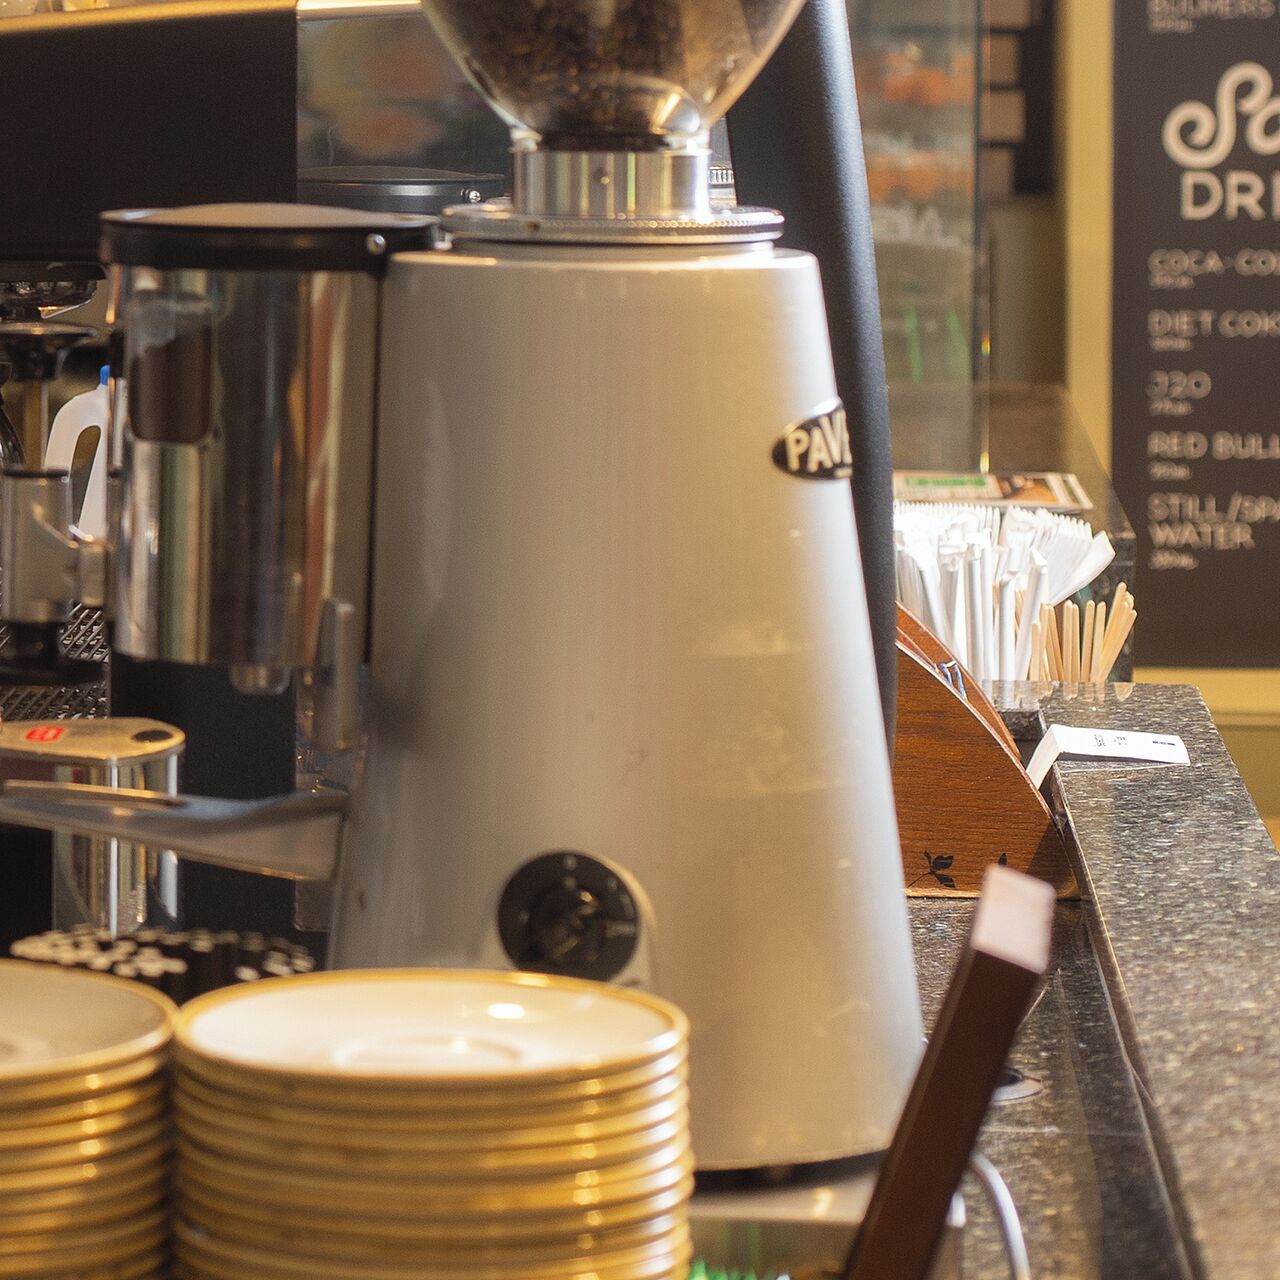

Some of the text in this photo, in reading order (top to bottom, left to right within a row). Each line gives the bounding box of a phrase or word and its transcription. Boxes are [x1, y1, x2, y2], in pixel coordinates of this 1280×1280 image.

[1147, 309, 1216, 337] DIET
[1147, 430, 1208, 460] RED
[1147, 521, 1256, 550] WATER
